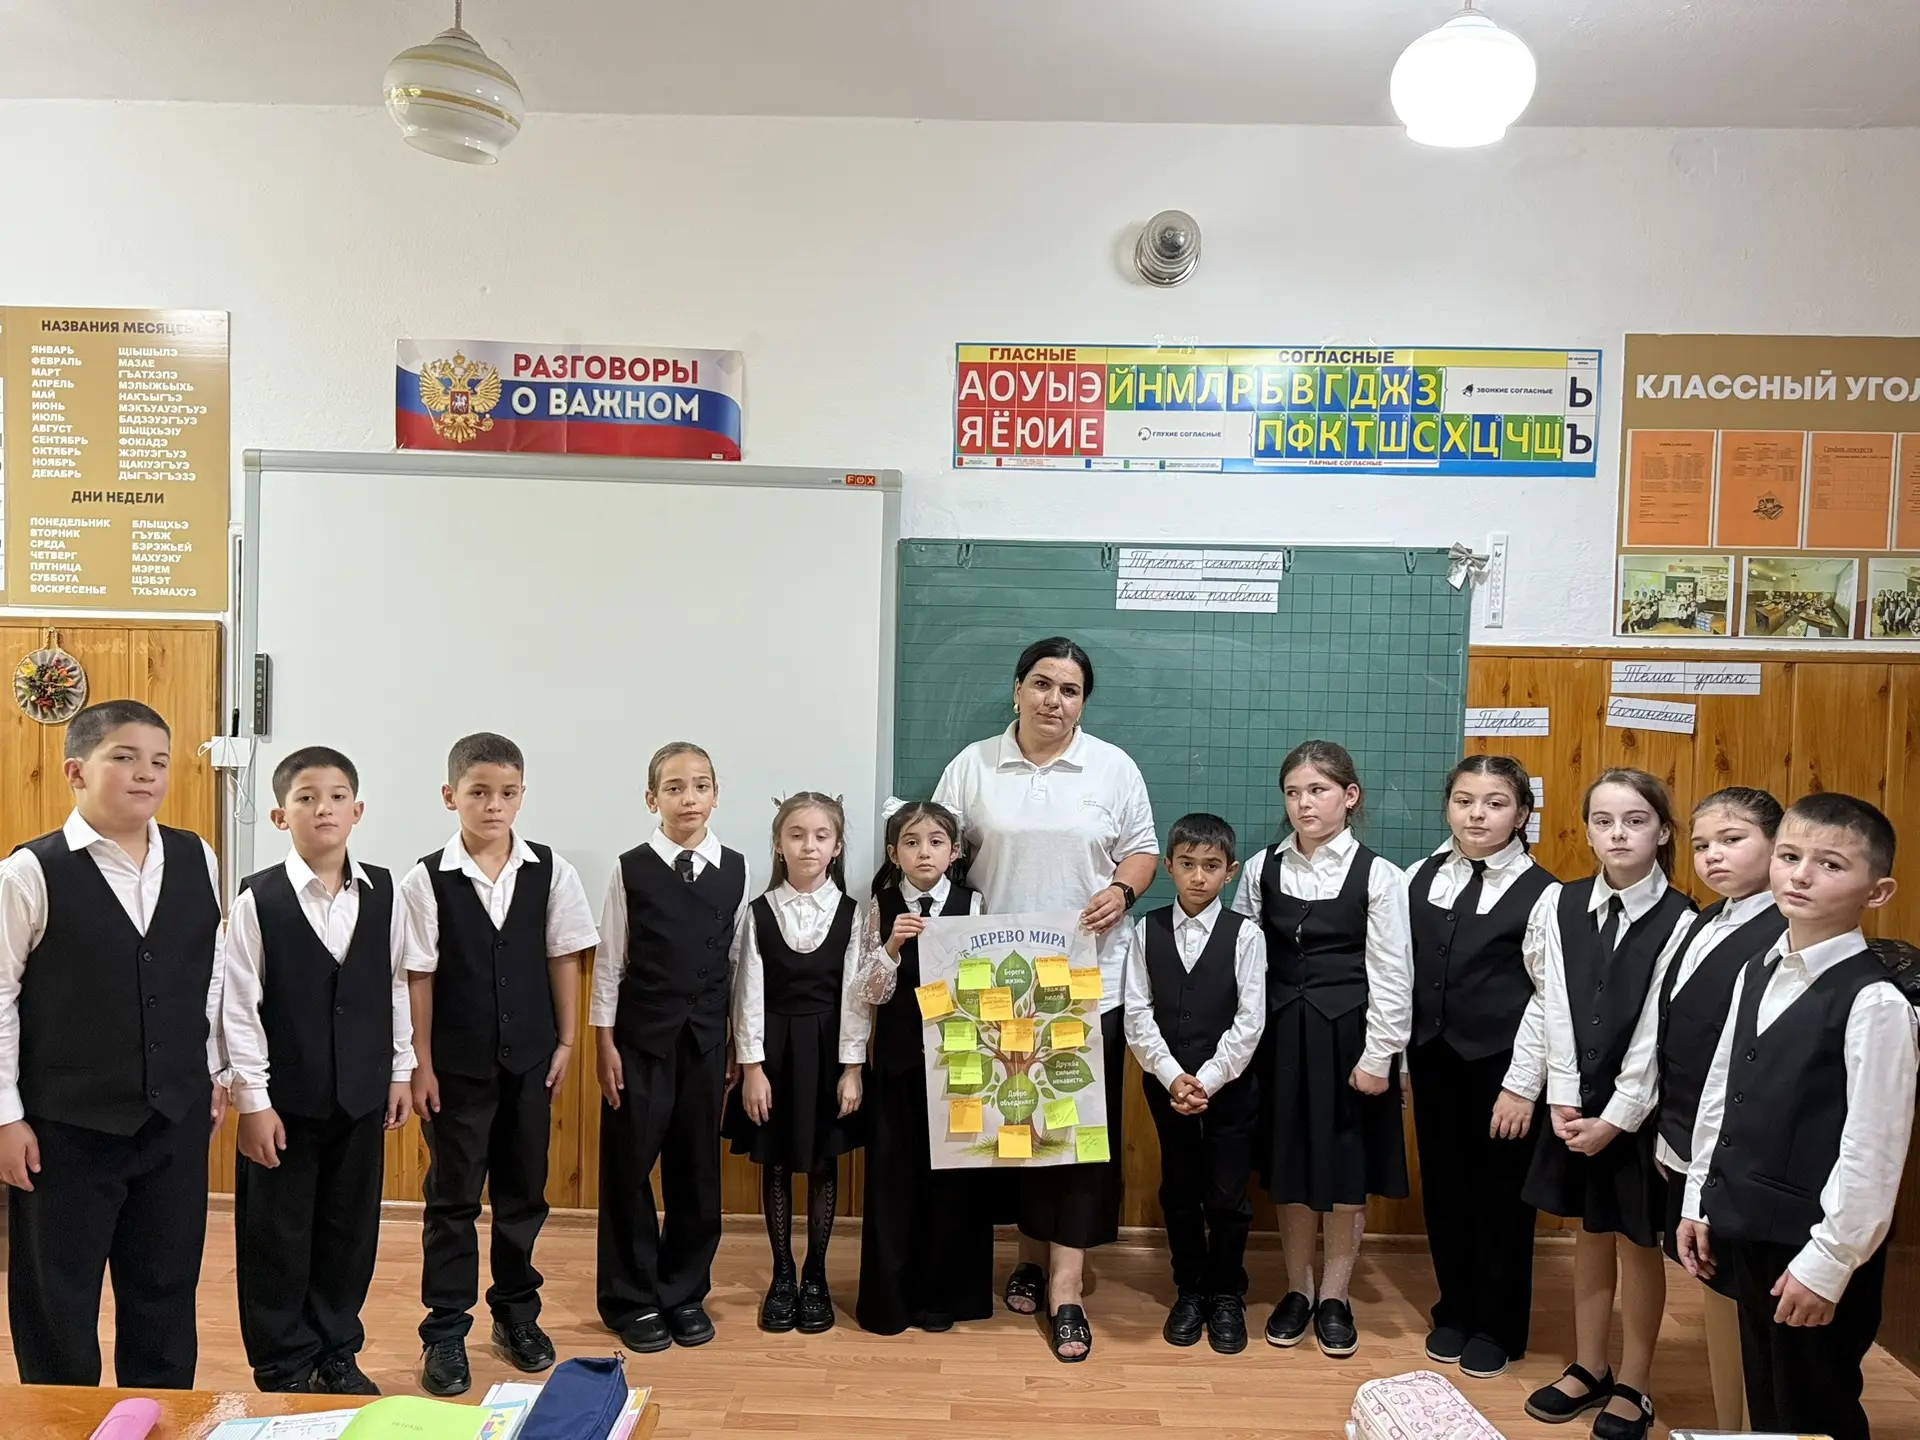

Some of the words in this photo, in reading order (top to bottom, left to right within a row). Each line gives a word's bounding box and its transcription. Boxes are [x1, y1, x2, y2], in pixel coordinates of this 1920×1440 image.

[41, 320, 119, 332] НАЗВАНИЯ
[32, 346, 74, 354] ЯНВАРЬ
[989, 348, 1076, 361] ГЛАСНЫЕ
[32, 357, 82, 366] ФЕВРАЛЬ
[1278, 350, 1394, 364] СОГЛАСНЫЕ
[512, 353, 698, 384] РАЗГОВОРЫ
[32, 380, 74, 388] АПРЕЛЬ
[1636, 369, 1836, 400] КЛАССНЫЙ
[32, 390, 55, 399] МАЙ
[32, 402, 65, 410] ИЮНЬ
[511, 387, 536, 414] О
[548, 388, 699, 421] ВАЖНОМ
[32, 414, 65, 422] ИЮЛЬ
[32, 425, 72, 433] АВГУСТ
[32, 436, 88, 445] СЕНТЯБРЬ
[32, 448, 81, 456] ОКТЯБРЬ
[32, 458, 76, 467] НОЯБРЬ
[32, 470, 81, 479] ДЕКАБРЬ
[848, 476, 874, 484] FOX
[72, 491, 102, 503] ДНИ
[107, 492, 164, 504] НЕДЕЛИ
[30, 518, 111, 527] ПОНЕДЕЛЬНИК
[30, 529, 80, 538] ВТОРНИК
[30, 540, 66, 549] СРЕДА
[30, 551, 78, 559] ЧЕТВЕРГ
[30, 562, 82, 572] ПЯТНИЦА
[30, 574, 79, 582] СУББОТА
[30, 585, 107, 594] ВОСКРЕСЕНЬЕ
[971, 930, 1024, 950] ДЕРЕВО
[1029, 930, 1066, 948] МИРА
[1055, 1060, 1079, 1068] Дружба
[1008, 1090, 1027, 1098] Добро
